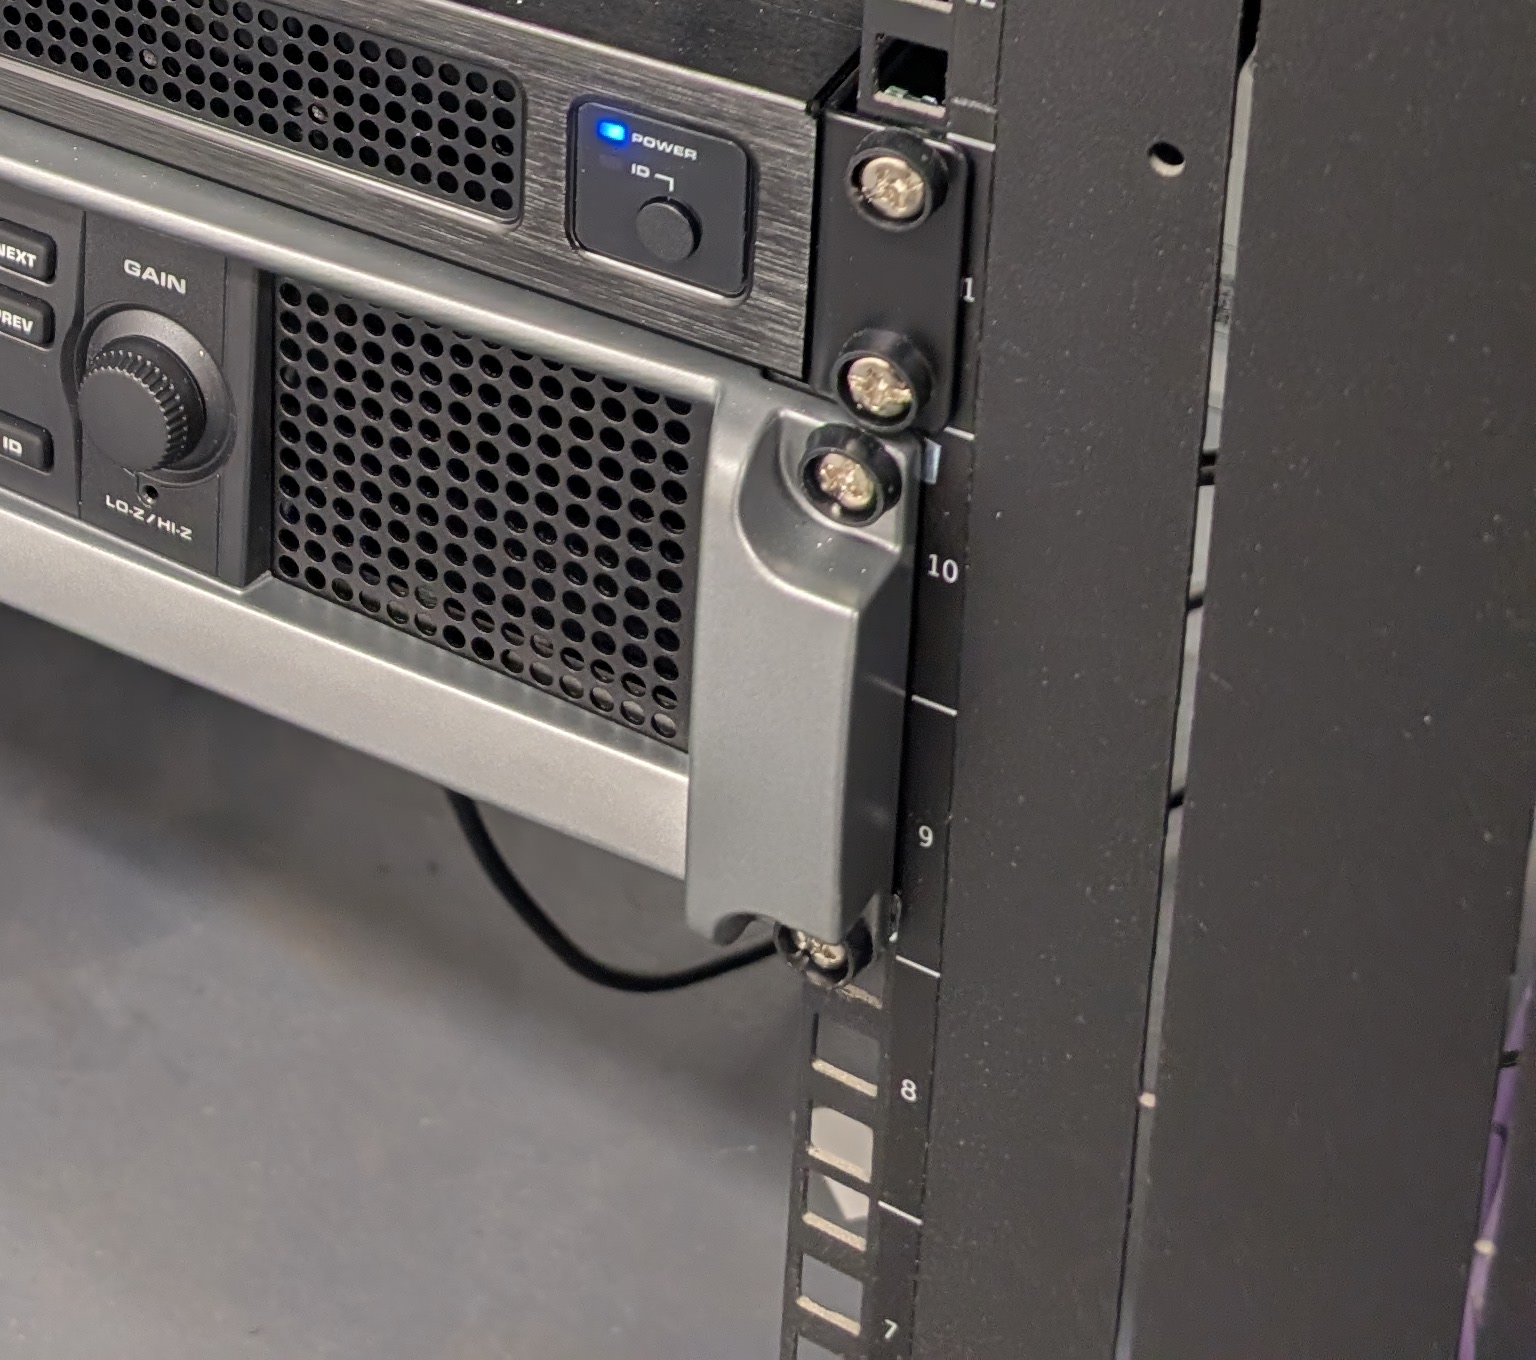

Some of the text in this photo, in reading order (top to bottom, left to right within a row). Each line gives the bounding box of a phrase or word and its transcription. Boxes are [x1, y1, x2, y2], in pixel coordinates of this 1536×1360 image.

[631, 132, 698, 161] POWER
[630, 163, 650, 178] ID
[123, 258, 187, 295] GAIN
[2, 435, 23, 455] ID
[927, 553, 959, 583] 10
[918, 825, 934, 848] 9
[900, 1078, 917, 1102] 8
[884, 1319, 898, 1340] 7
